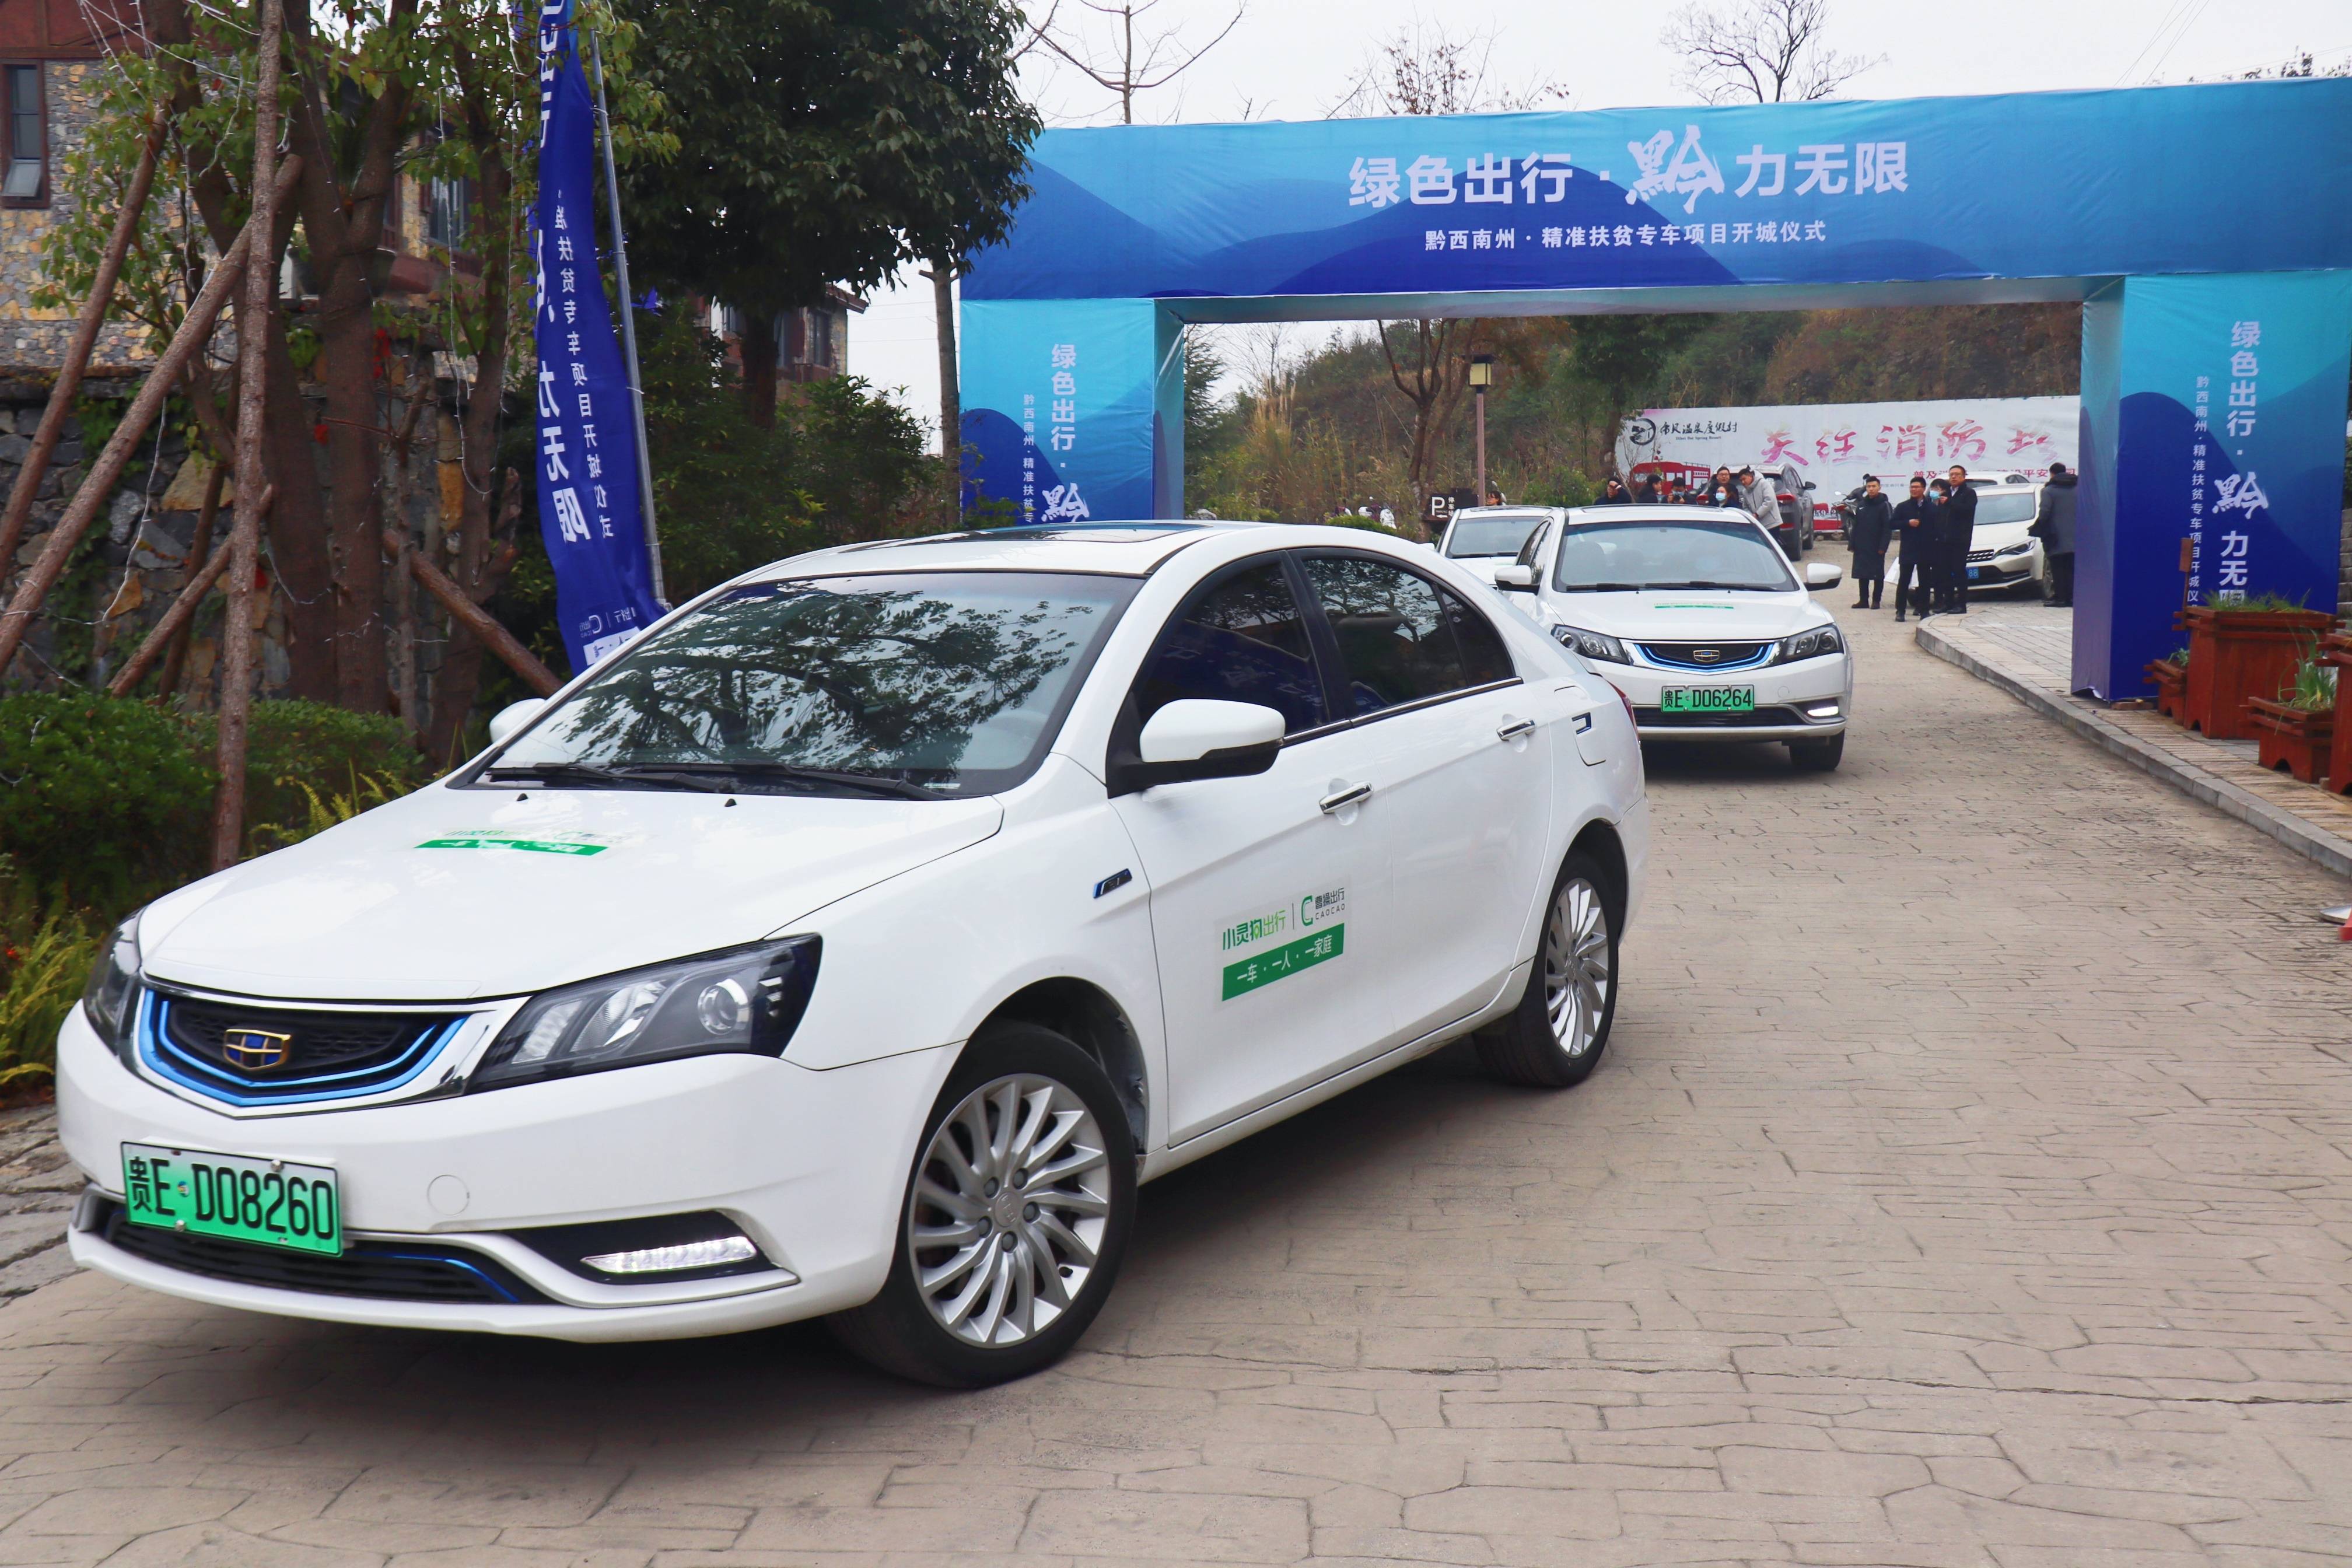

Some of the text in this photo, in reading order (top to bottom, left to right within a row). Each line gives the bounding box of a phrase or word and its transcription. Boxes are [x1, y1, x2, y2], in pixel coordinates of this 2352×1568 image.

[1424, 219, 1827, 251] 黔西南州·精准扶贫专车项目开城仪式
[2186, 376, 2210, 604] 黔西南州·精准扶贫专车项目开城仪
[1432, 496, 1445, 516] P
[1692, 688, 1752, 708] D06264
[1315, 887, 1345, 910] 曹操出行
[1315, 904, 1345, 920] CAOCAO
[191, 1163, 334, 1240] D08260
